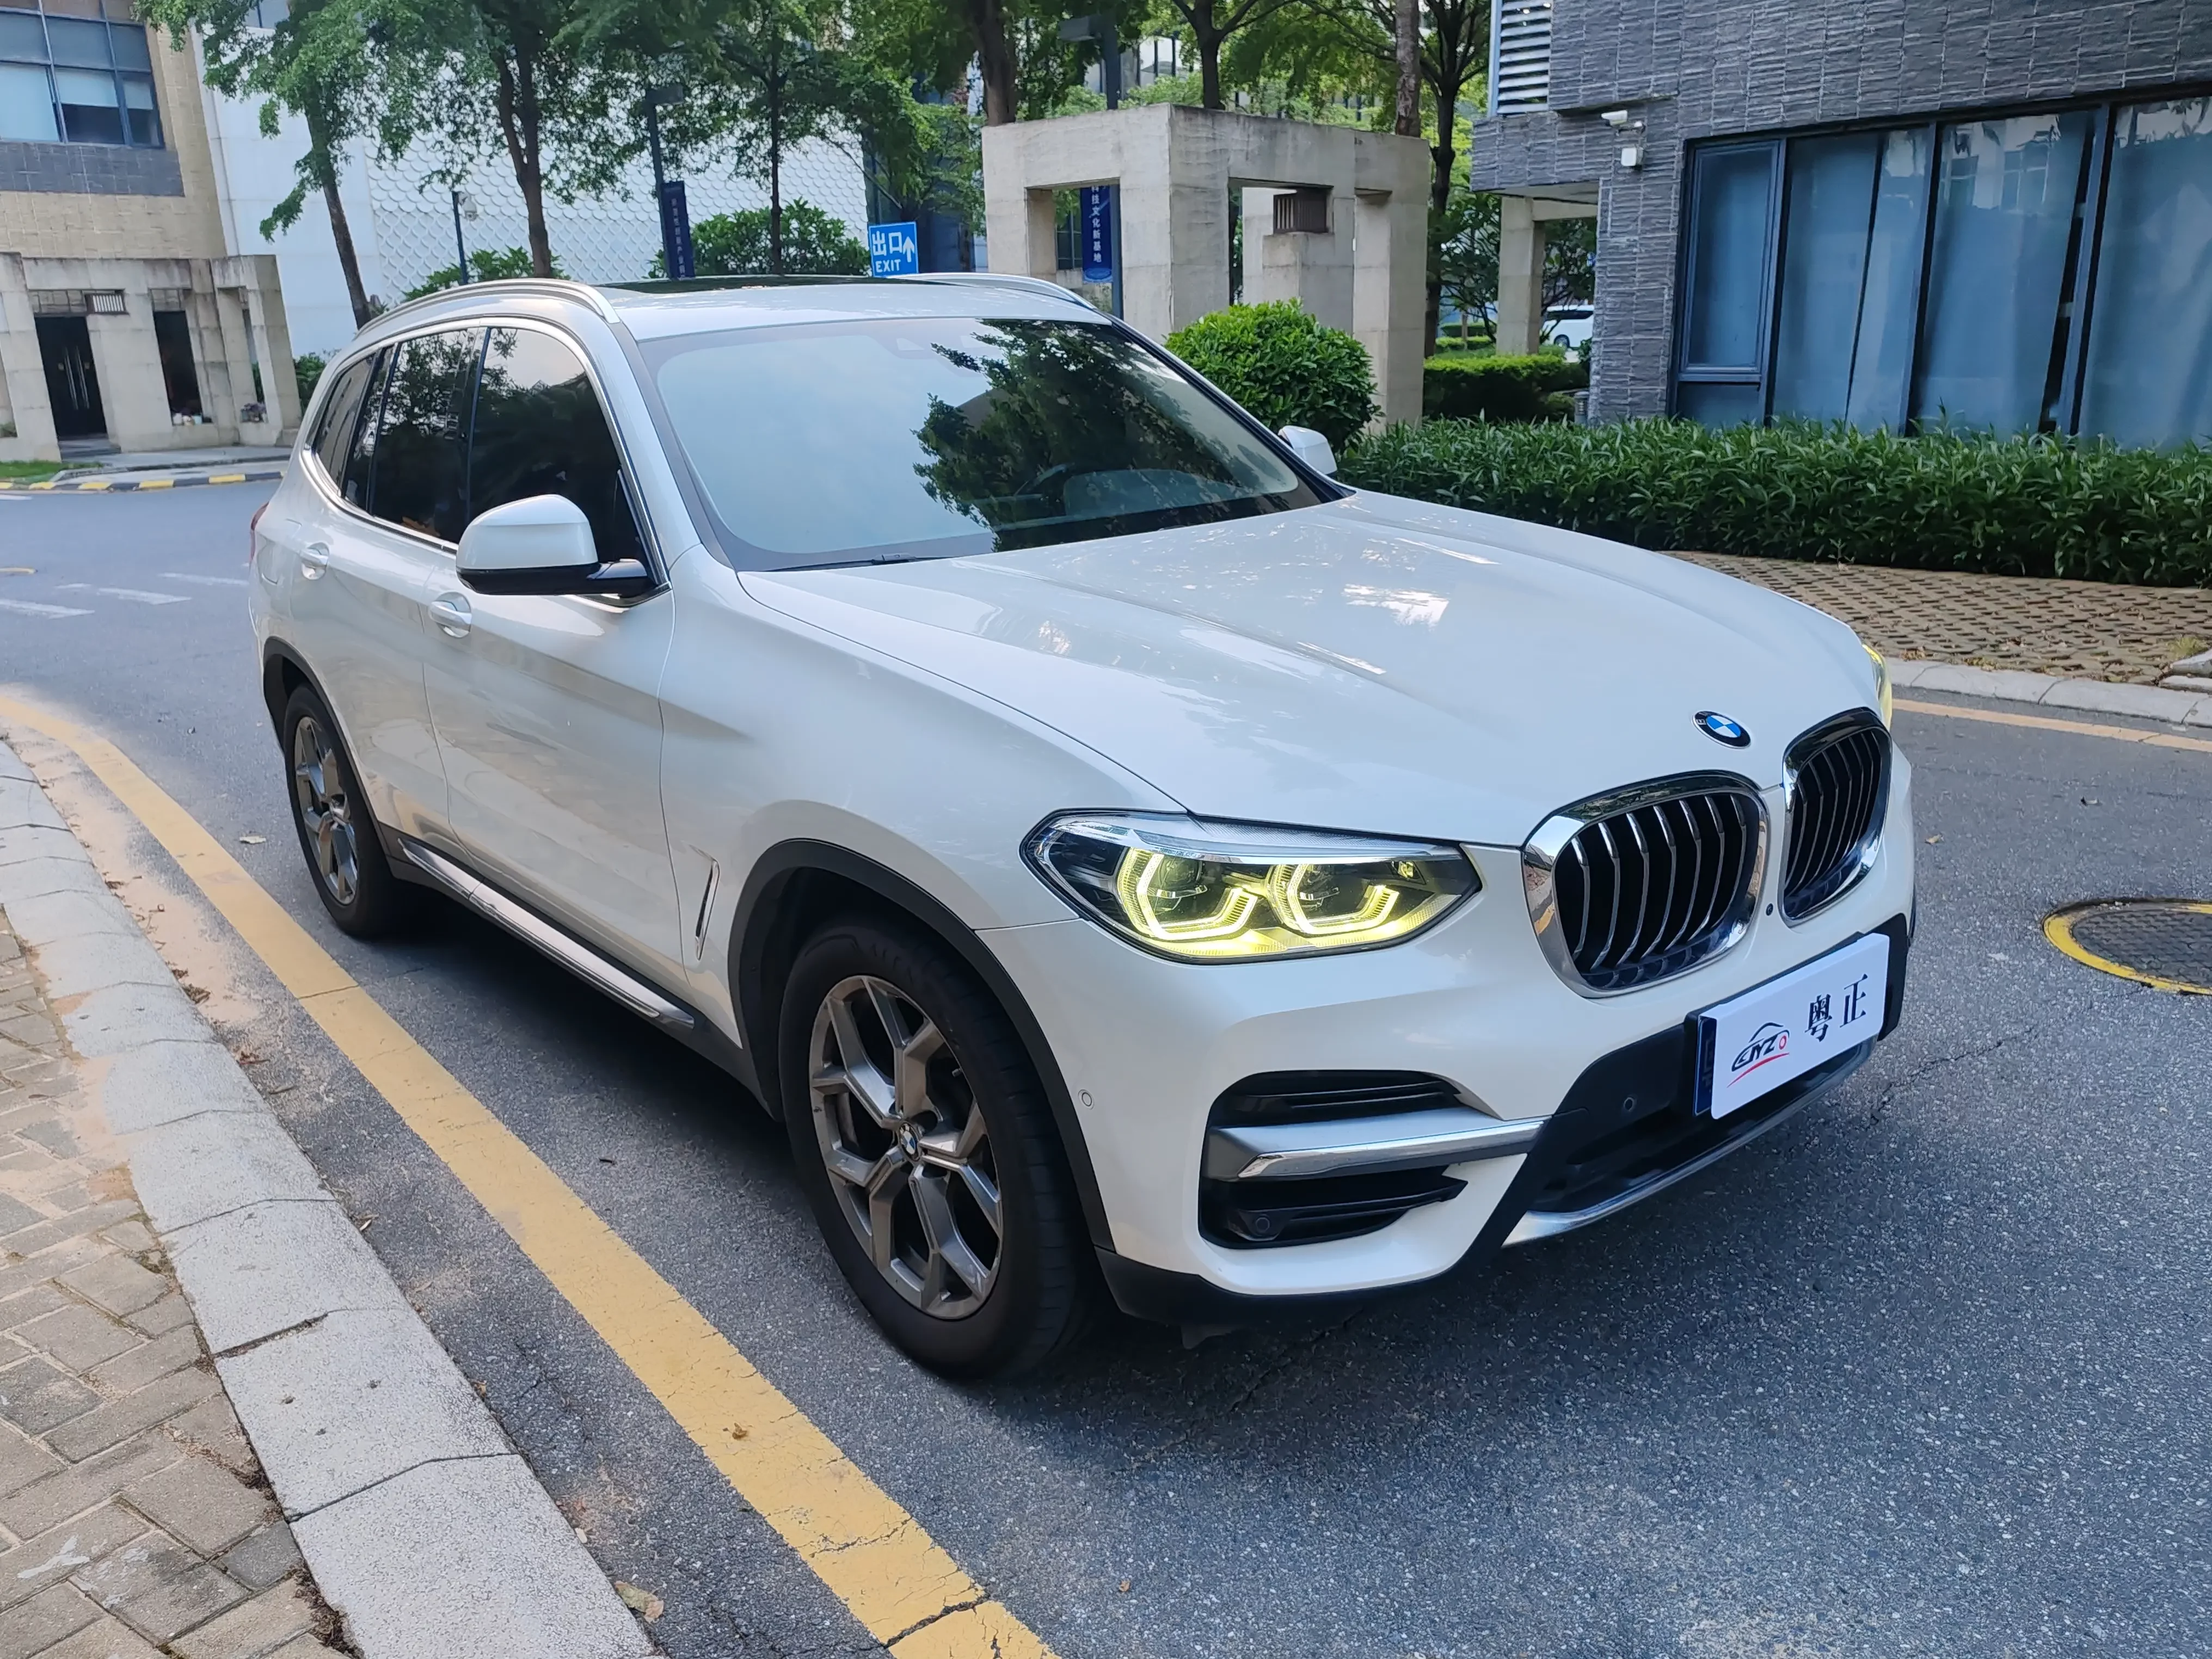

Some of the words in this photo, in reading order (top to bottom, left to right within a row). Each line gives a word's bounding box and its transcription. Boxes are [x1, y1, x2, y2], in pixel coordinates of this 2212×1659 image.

[872, 231, 902, 256] 出口
[875, 259, 901, 273] EXIT
[1804, 973, 1868, 1042] 粤正
